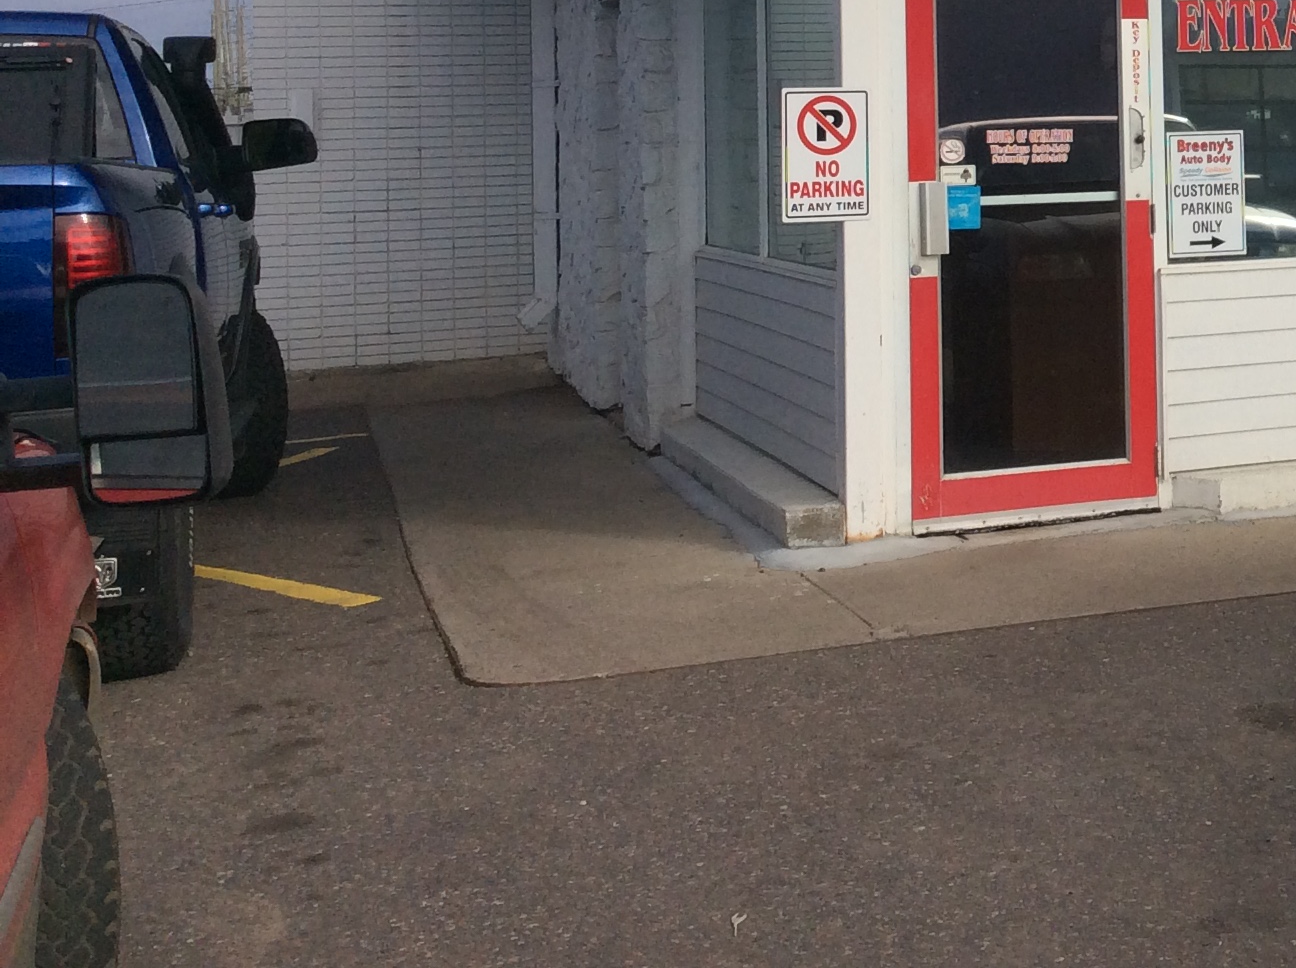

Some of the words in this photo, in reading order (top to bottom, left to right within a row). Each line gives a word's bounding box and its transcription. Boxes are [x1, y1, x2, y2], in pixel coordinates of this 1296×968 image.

[1131, 21, 1140, 44] Key
[1016, 129, 1028, 143] OF
[1177, 138, 1234, 154] Breeny's
[1180, 155, 1203, 164] Auto
[1206, 154, 1232, 165] Body
[815, 160, 840, 178] NO
[790, 180, 865, 199] PARKING
[1173, 183, 1239, 198] CUSTOMER
[790, 203, 804, 212] AT
[807, 202, 832, 212] ANY
[836, 201, 864, 210] TIME
[1181, 201, 1233, 215] PARKING
[1192, 220, 1222, 234] ONLY
